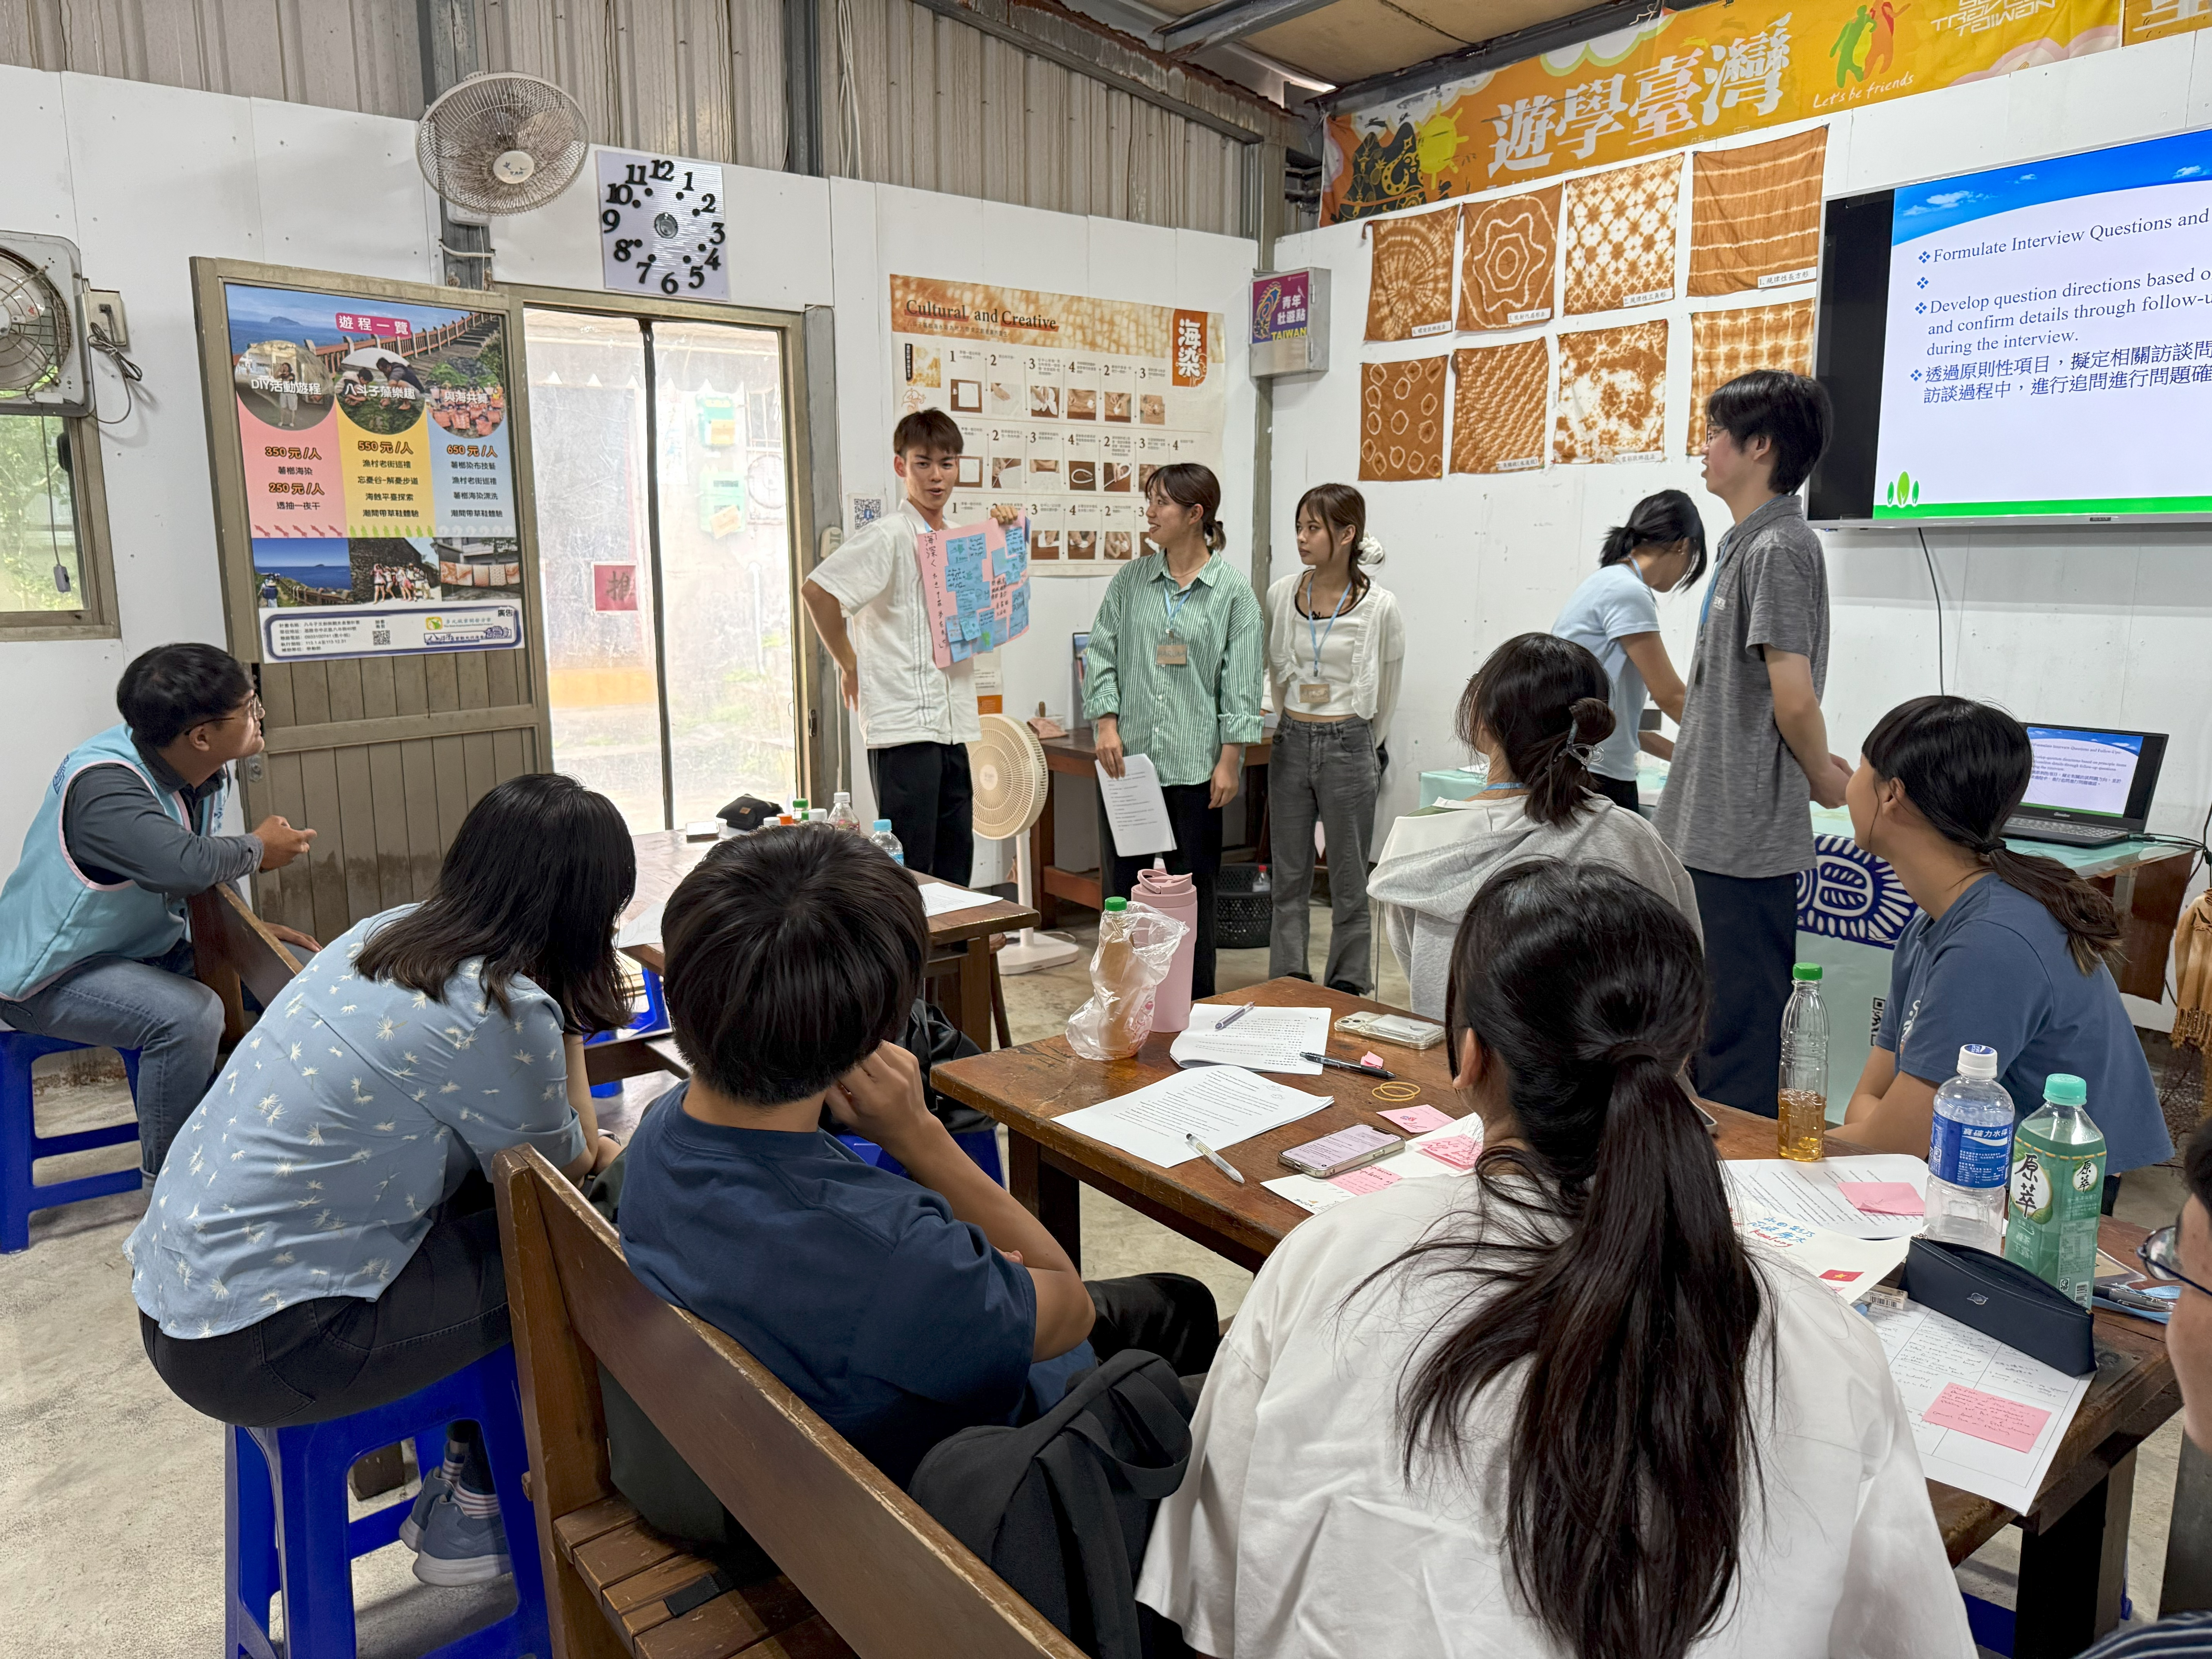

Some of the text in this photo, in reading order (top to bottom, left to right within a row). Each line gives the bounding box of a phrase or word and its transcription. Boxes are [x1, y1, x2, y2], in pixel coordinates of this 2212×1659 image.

[1488, 12, 1794, 178] 遊學臺灣
[1813, 74, 1914, 109] Let's be friends
[625, 164, 647, 185] 11
[649, 160, 675, 181] 12
[683, 172, 694, 191] 1
[606, 183, 633, 205] 10
[701, 193, 716, 213] 2
[602, 209, 620, 234] 9
[709, 222, 725, 245] 3
[1934, 209, 2209, 263] Formulate Interview Questions and
[614, 239, 634, 262] 8
[704, 248, 721, 271] 4
[636, 262, 652, 284] 7
[689, 265, 705, 289] 5
[661, 272, 679, 295] 6
[1930, 268, 2212, 315] Develop question directions based o
[1282, 294, 1301, 309] 青年
[907, 300, 1056, 329] Cultural and Creative
[1927, 320, 1953, 335] and
[1957, 315, 2014, 332] confirm
[2020, 308, 2068, 325] details
[2074, 300, 2136, 319] through
[339, 314, 409, 335] 遊程一覽
[1271, 327, 1307, 341] TAIWAN
[1178, 319, 1202, 378] 海染
[1927, 330, 2079, 357] during the interview.
[950, 350, 957, 362] 1
[991, 354, 997, 366] 2
[1029, 358, 1036, 369] 3
[1069, 361, 1075, 373] 4
[1104, 365, 1110, 376] 2
[1140, 368, 1146, 379] 3
[251, 379, 322, 395] DIY活動遊程
[345, 384, 416, 400] 八斗子藻樂趣
[445, 391, 488, 404] 與海共舞
[992, 429, 999, 441] 2
[1030, 432, 1036, 443] 3
[1068, 434, 1074, 445] 4
[1104, 436, 1110, 447] 2
[358, 441, 414, 454] 550 元 /人
[1139, 438, 1146, 449] 3
[1173, 440, 1179, 450] 4
[265, 447, 322, 460] 350 元 /人
[447, 445, 498, 458] 650 元 /人
[269, 483, 325, 495] 250 元 /人
[952, 502, 958, 514] 1
[1031, 504, 1038, 515] 3
[1069, 505, 1076, 515] 4
[1105, 506, 1111, 516] 2
[1139, 507, 1144, 517] 3
[498, 609, 513, 617] 廣告
[1963, 1127, 2008, 1138] 寶礦力水得
[2077, 1160, 2091, 1194] 原萃
[2014, 1153, 2038, 1218] 原萃
